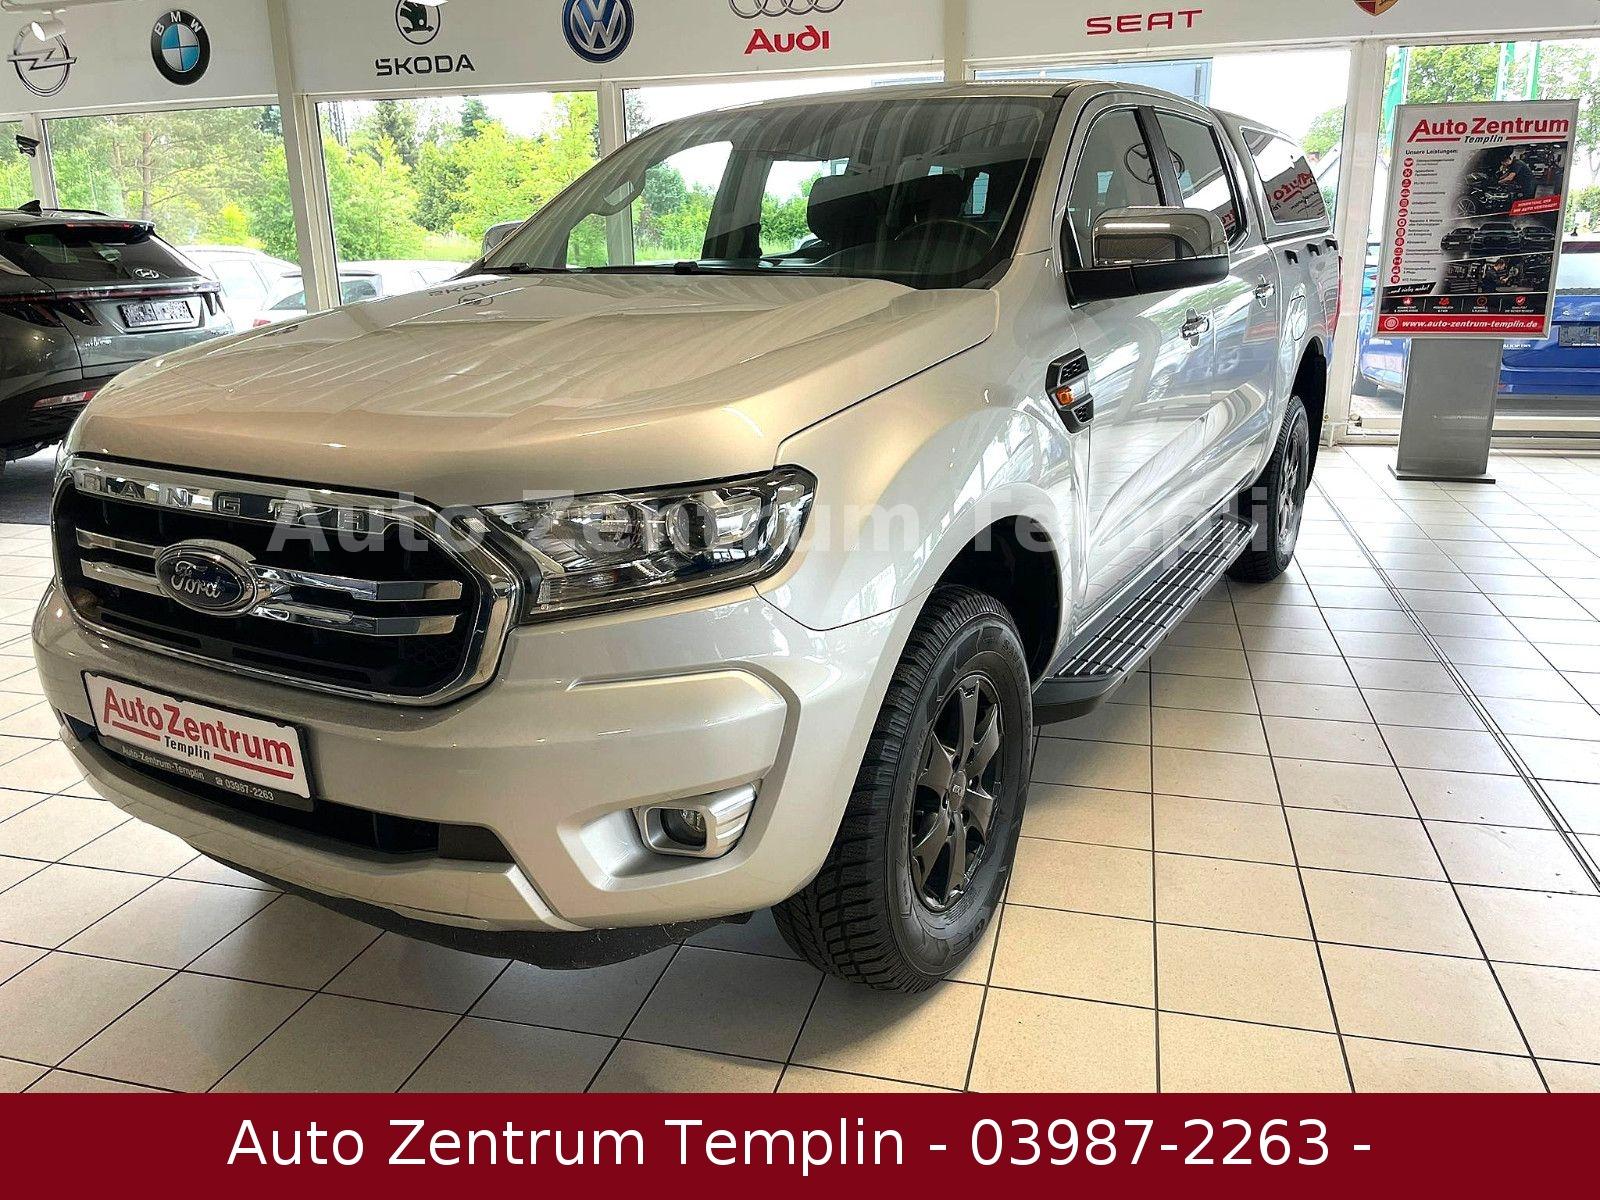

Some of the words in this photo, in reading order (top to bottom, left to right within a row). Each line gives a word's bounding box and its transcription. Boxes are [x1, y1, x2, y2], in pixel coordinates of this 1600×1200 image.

[154, 11, 202, 37] BMW
[1086, 9, 1203, 36] SEAT
[744, 25, 830, 55] Audi
[1407, 119, 1468, 143] Auto
[1471, 117, 1569, 135] Zentrum
[1464, 135, 1504, 144] Templin
[1402, 319, 1538, 329] www.auto-zentrum-templin.de
[170, 560, 222, 599] Ford
[103, 686, 164, 731] Auto
[163, 703, 295, 768] Zentrum
[165, 735, 211, 761] Templin
[122, 746, 205, 781] Auto-Zentrum-Templin
[225, 778, 274, 801] 03987-2263
